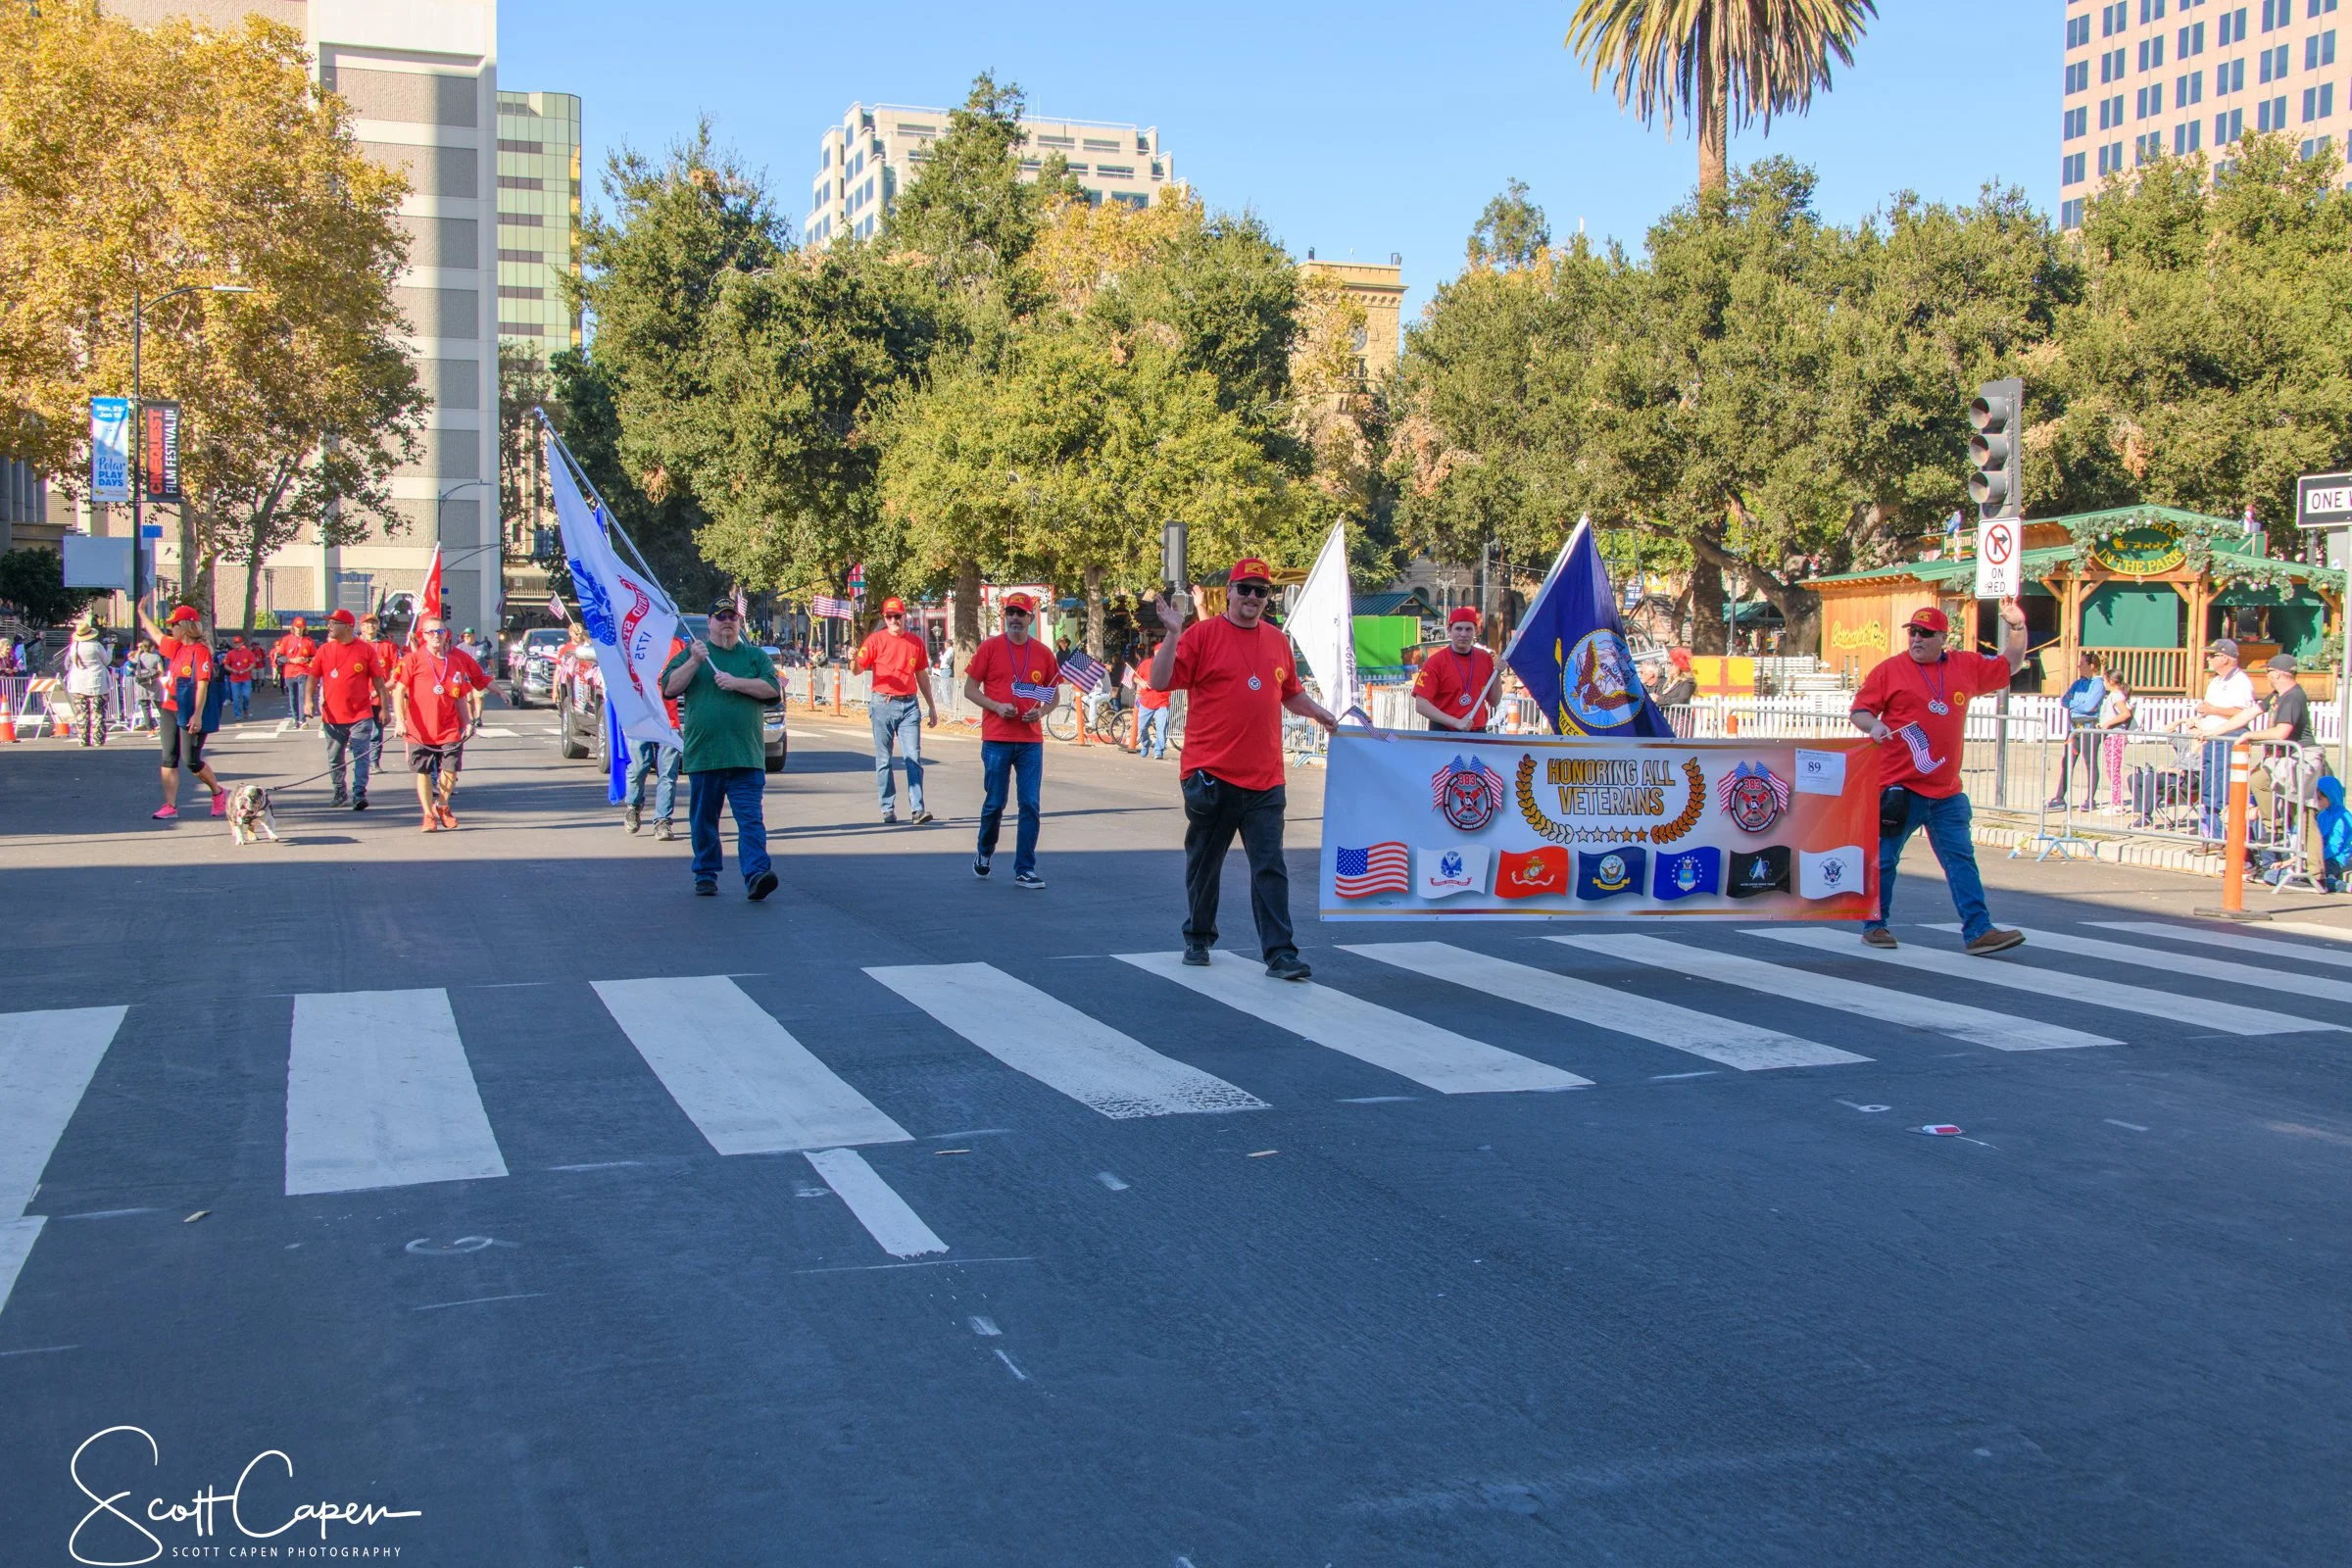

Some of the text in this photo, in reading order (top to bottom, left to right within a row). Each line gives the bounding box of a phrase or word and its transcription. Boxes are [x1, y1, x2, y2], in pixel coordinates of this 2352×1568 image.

[148, 408, 163, 495] CINEQUEST
[165, 419, 177, 494] FILM FESTIVAL
[98, 456, 126, 471] Polar
[2312, 492, 2343, 510] ONE
[2116, 558, 2146, 573] THE
[2147, 547, 2182, 572] PARK
[1991, 567, 2004, 579] ON
[1987, 581, 2006, 594] RED
[1547, 759, 1677, 787] HONORING ALL
[1808, 760, 1821, 773] 89
[1558, 786, 1665, 816] VETERANS
